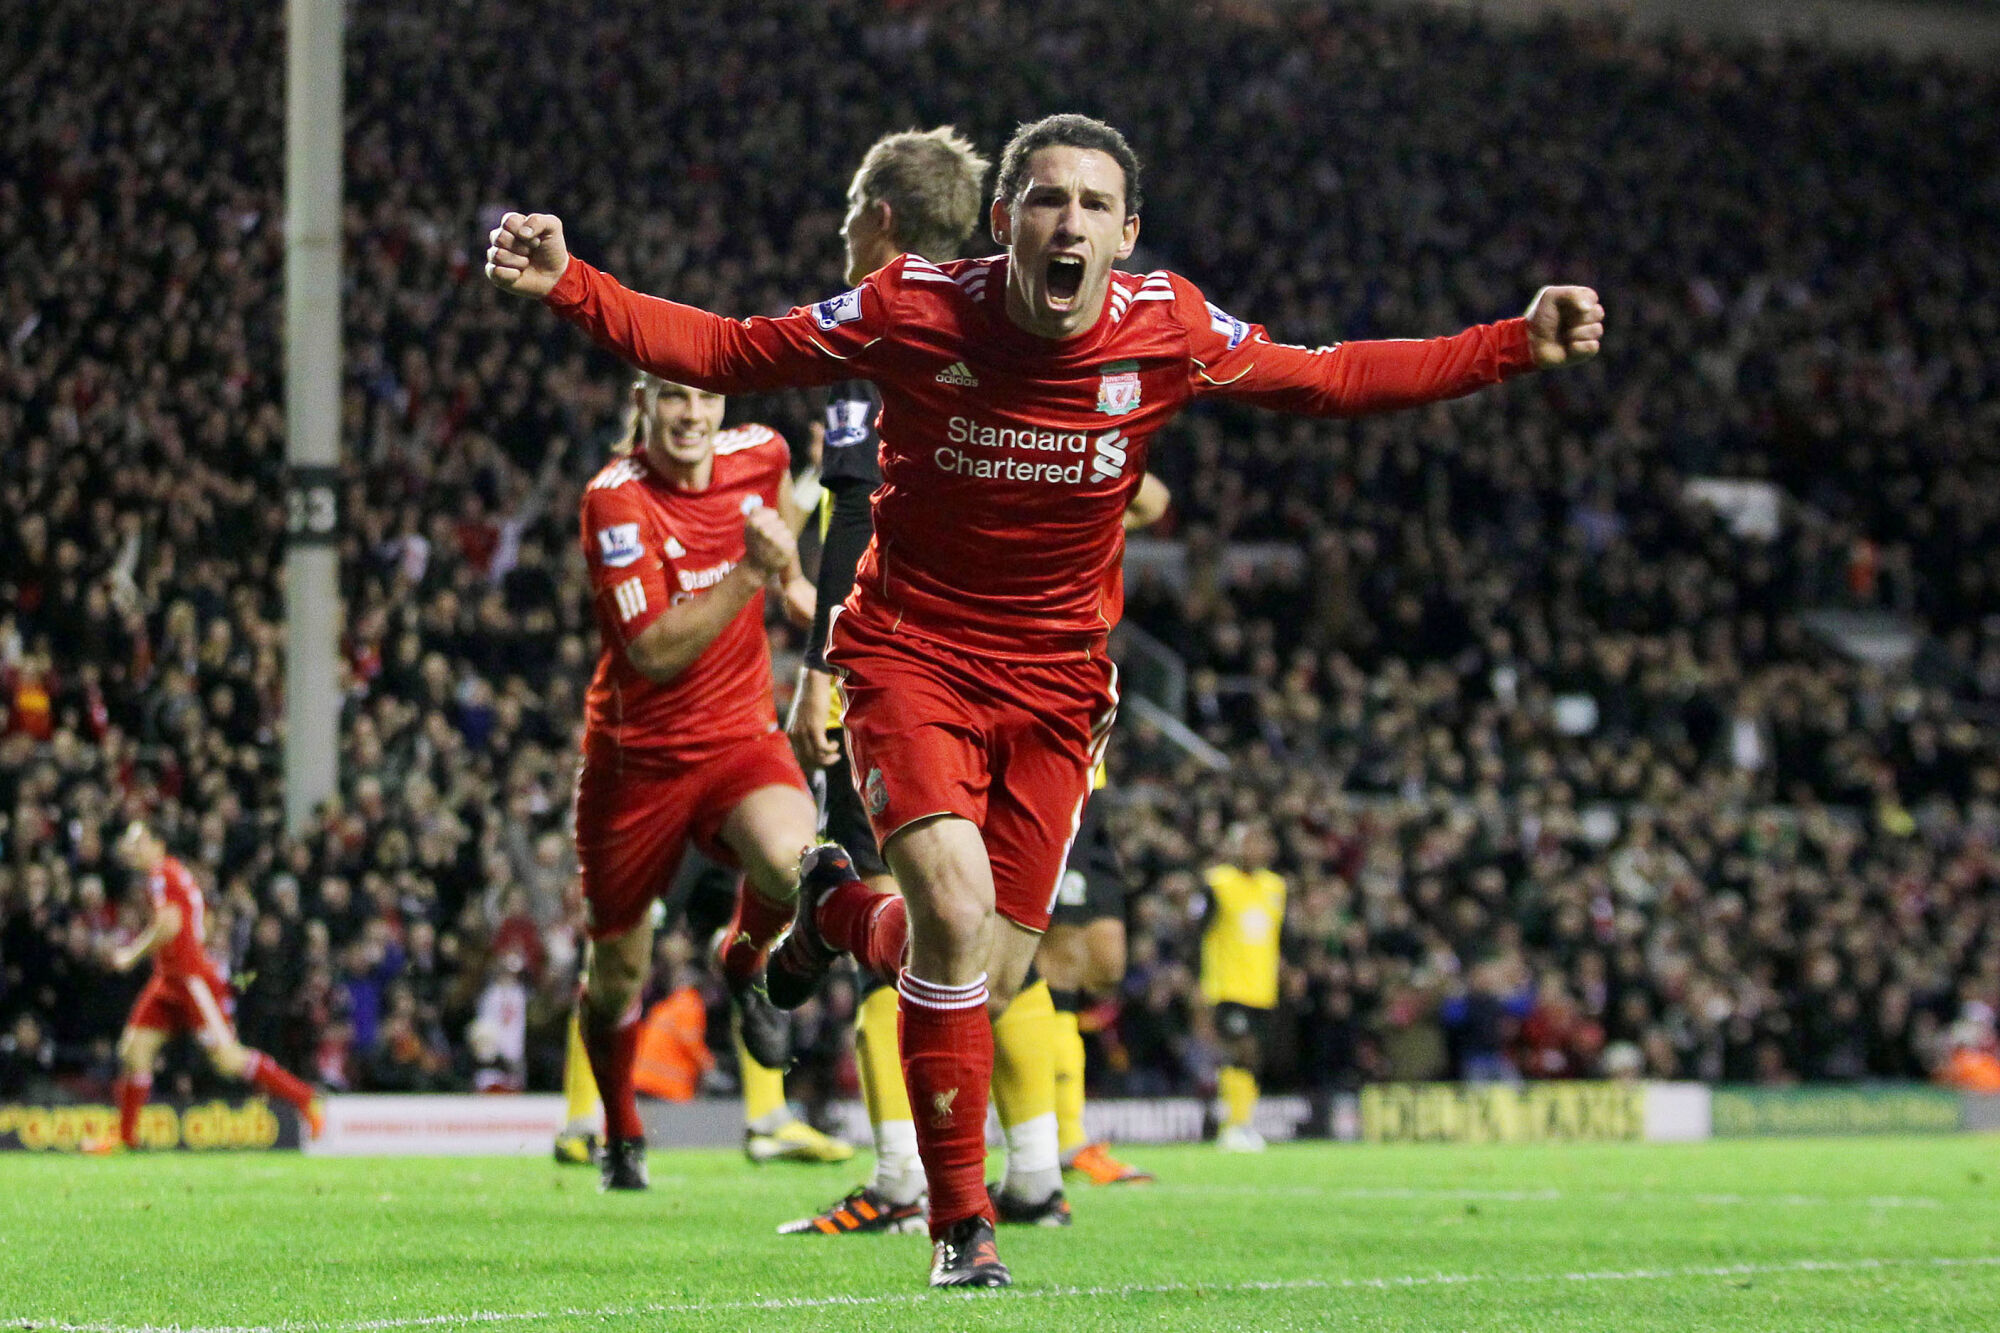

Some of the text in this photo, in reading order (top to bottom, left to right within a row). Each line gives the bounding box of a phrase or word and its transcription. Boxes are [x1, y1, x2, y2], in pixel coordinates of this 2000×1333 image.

[935, 374, 979, 387] adidas
[947, 416, 1088, 453] Standard
[934, 447, 1083, 483] Chartered
[678, 560, 737, 592] Stand
